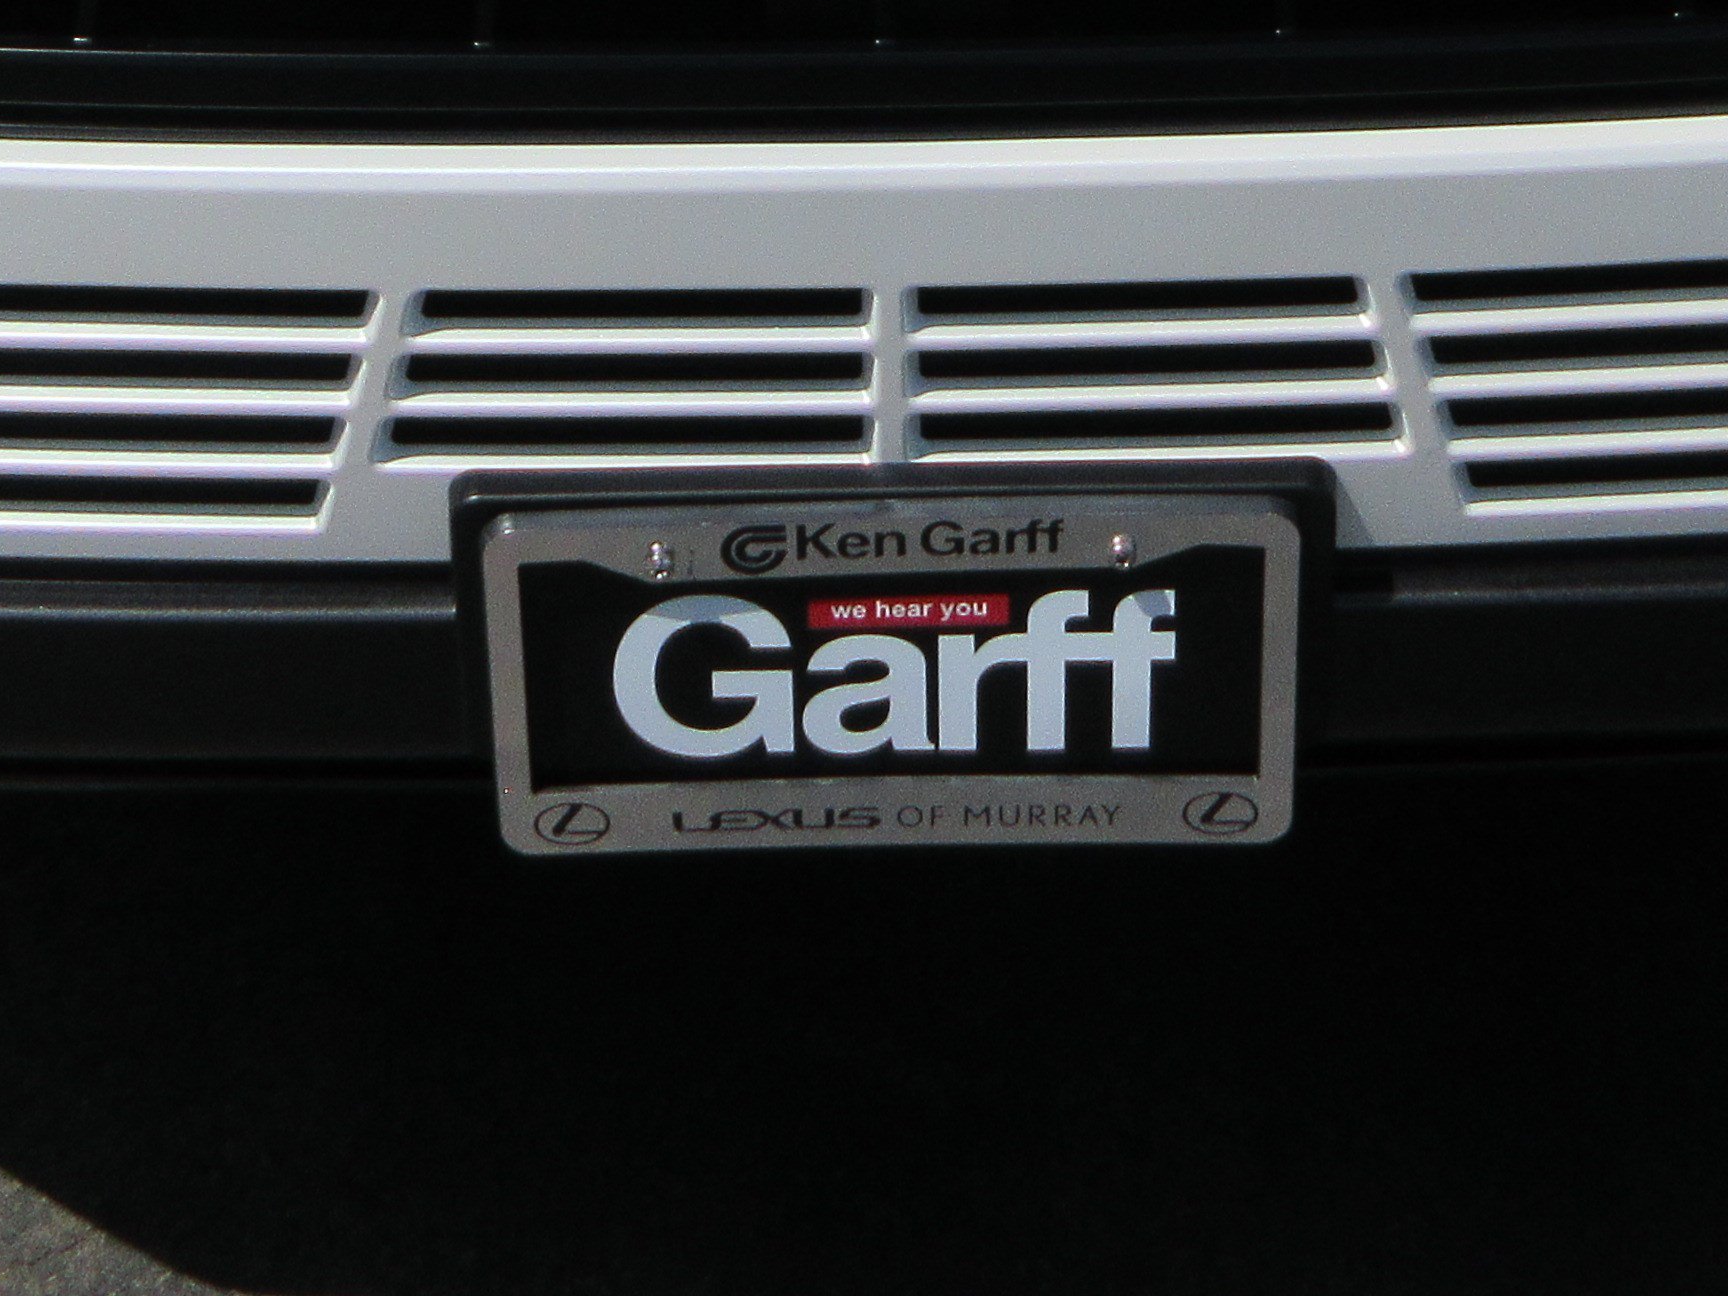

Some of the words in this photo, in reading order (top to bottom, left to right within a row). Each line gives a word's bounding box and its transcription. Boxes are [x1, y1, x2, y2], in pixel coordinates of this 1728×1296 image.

[795, 523, 908, 561] Ken
[921, 518, 1065, 556] Garff
[830, 602, 866, 619] we
[875, 600, 933, 619] hear
[939, 601, 988, 621] you
[612, 589, 1177, 759] Garff
[672, 808, 881, 833] LEXUS
[896, 805, 946, 829] OF
[962, 804, 1123, 829] MURRAY
